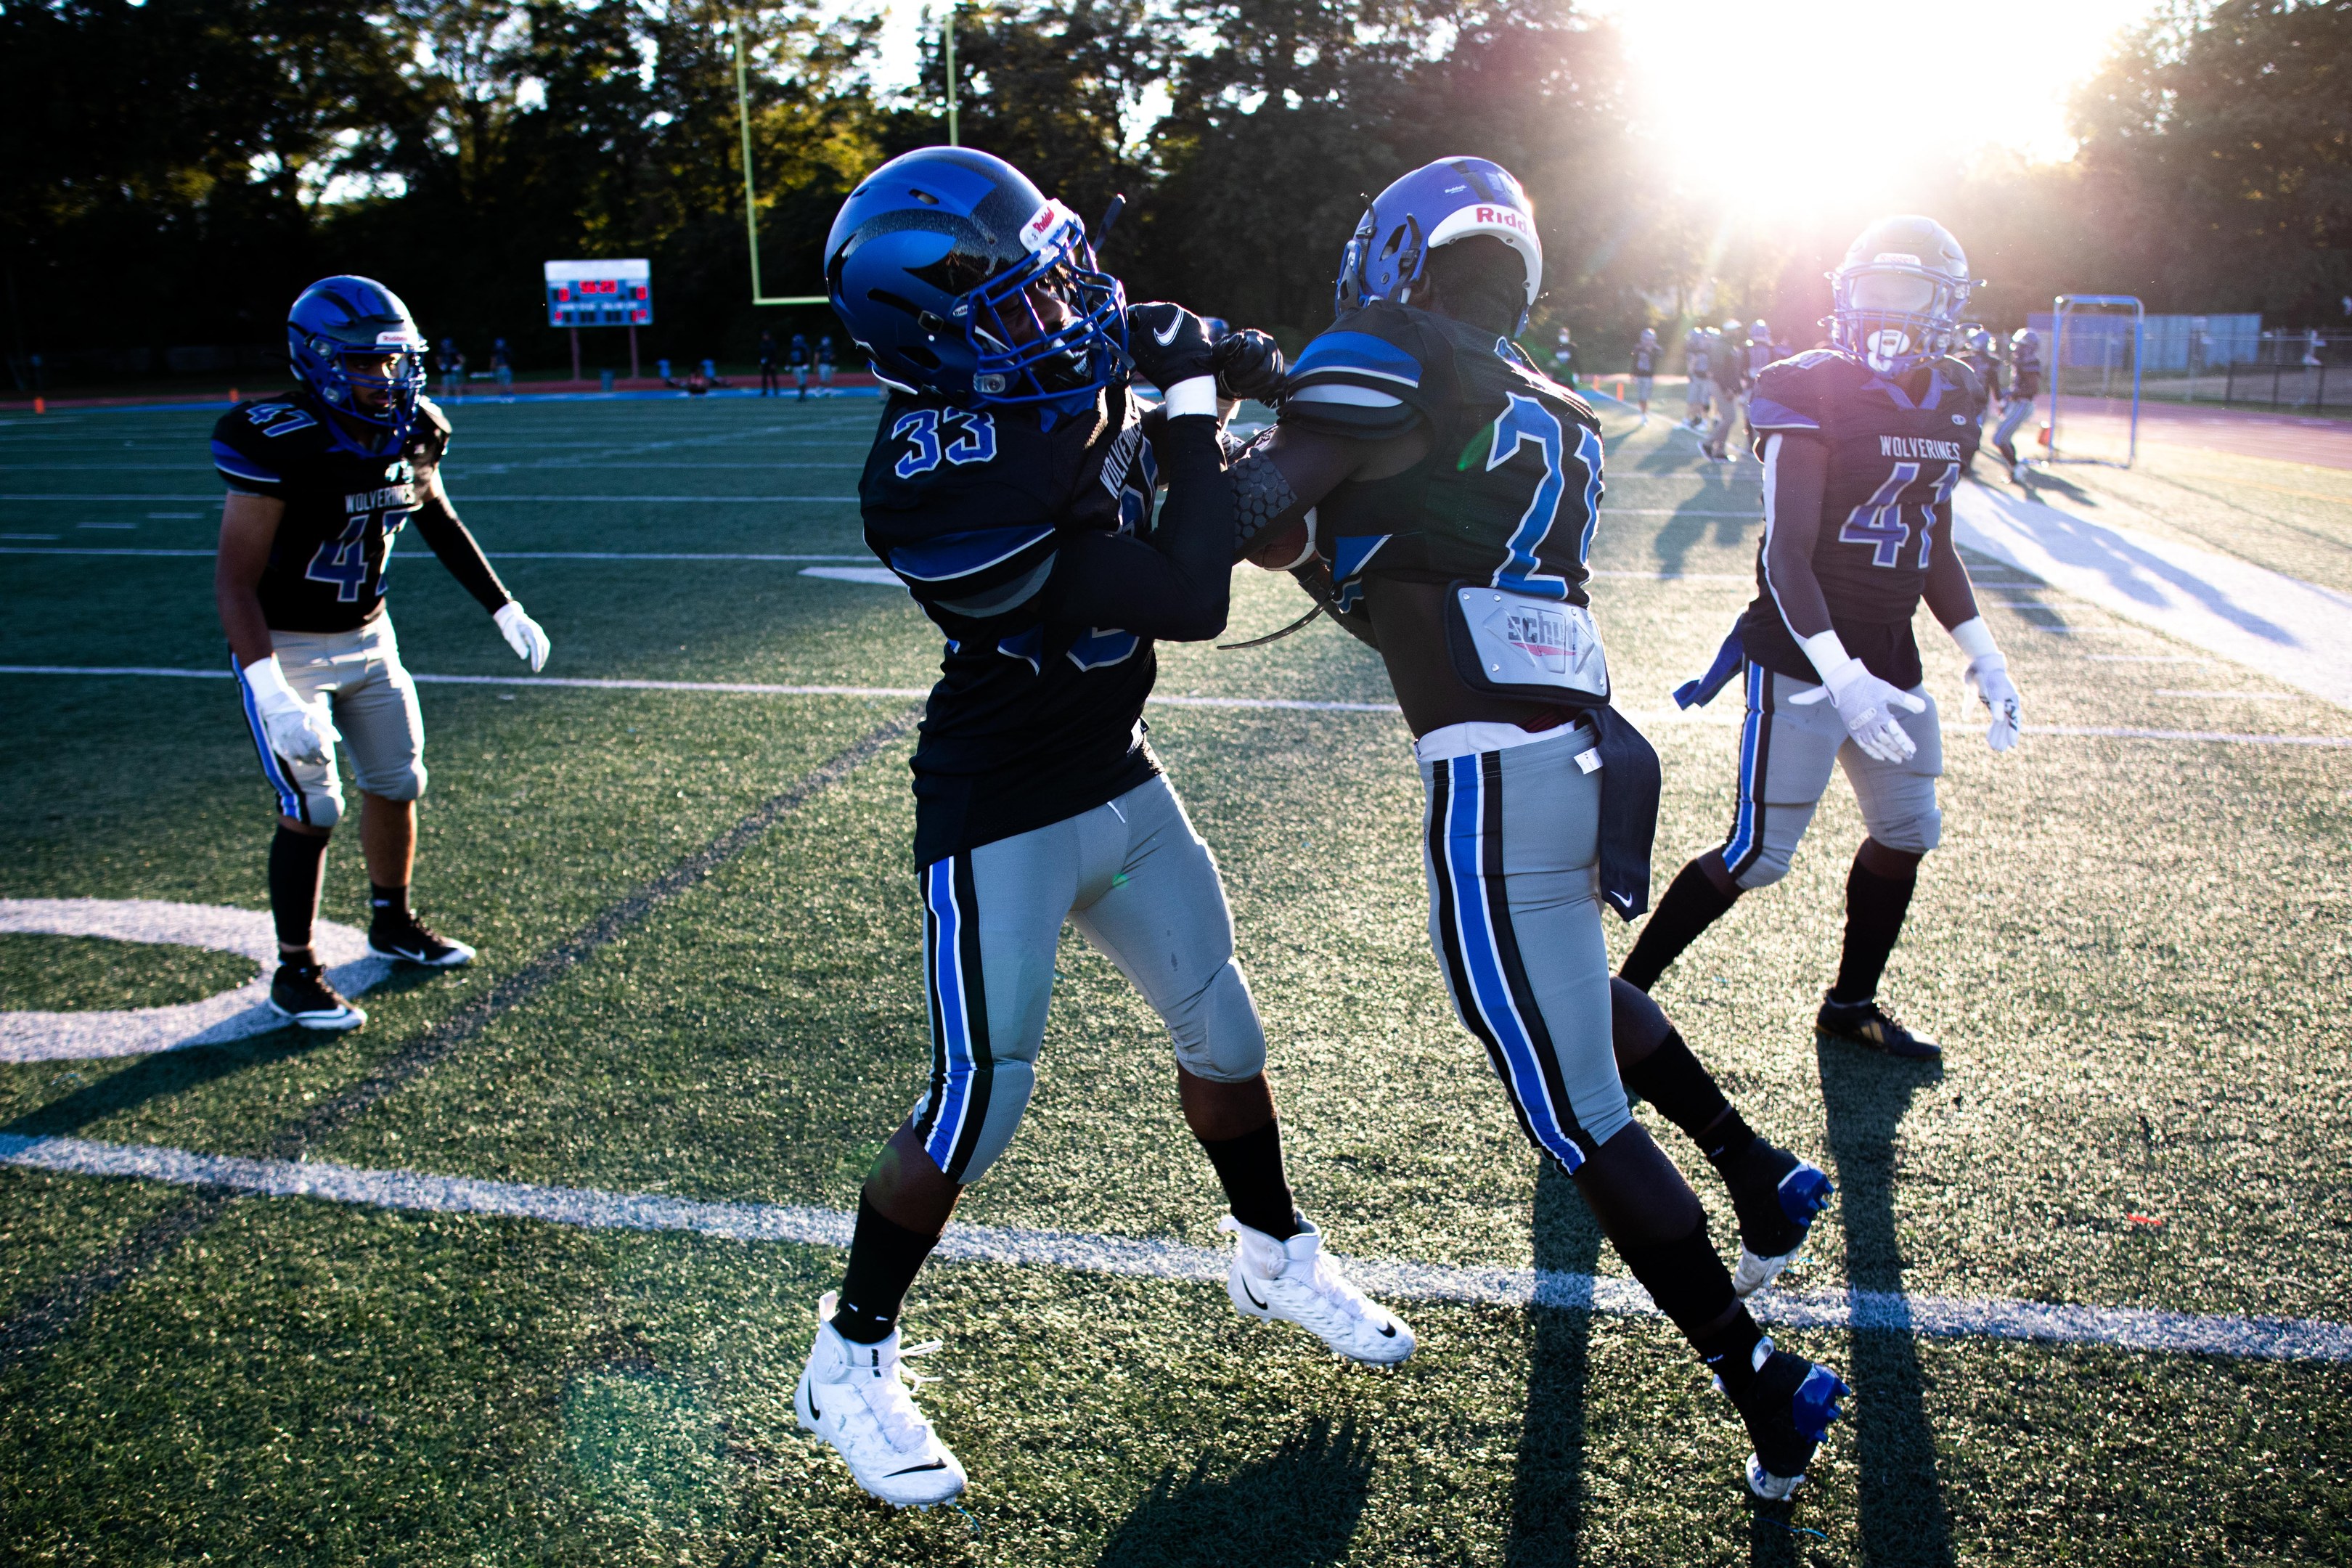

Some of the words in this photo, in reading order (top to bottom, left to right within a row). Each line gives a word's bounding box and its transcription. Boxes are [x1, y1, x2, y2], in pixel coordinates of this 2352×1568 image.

[245, 403, 318, 437] 47
[891, 407, 997, 479] 33
[1879, 436, 1962, 462] WOLVERINES
[1486, 391, 1606, 606] 21
[1839, 462, 1960, 568] 41
